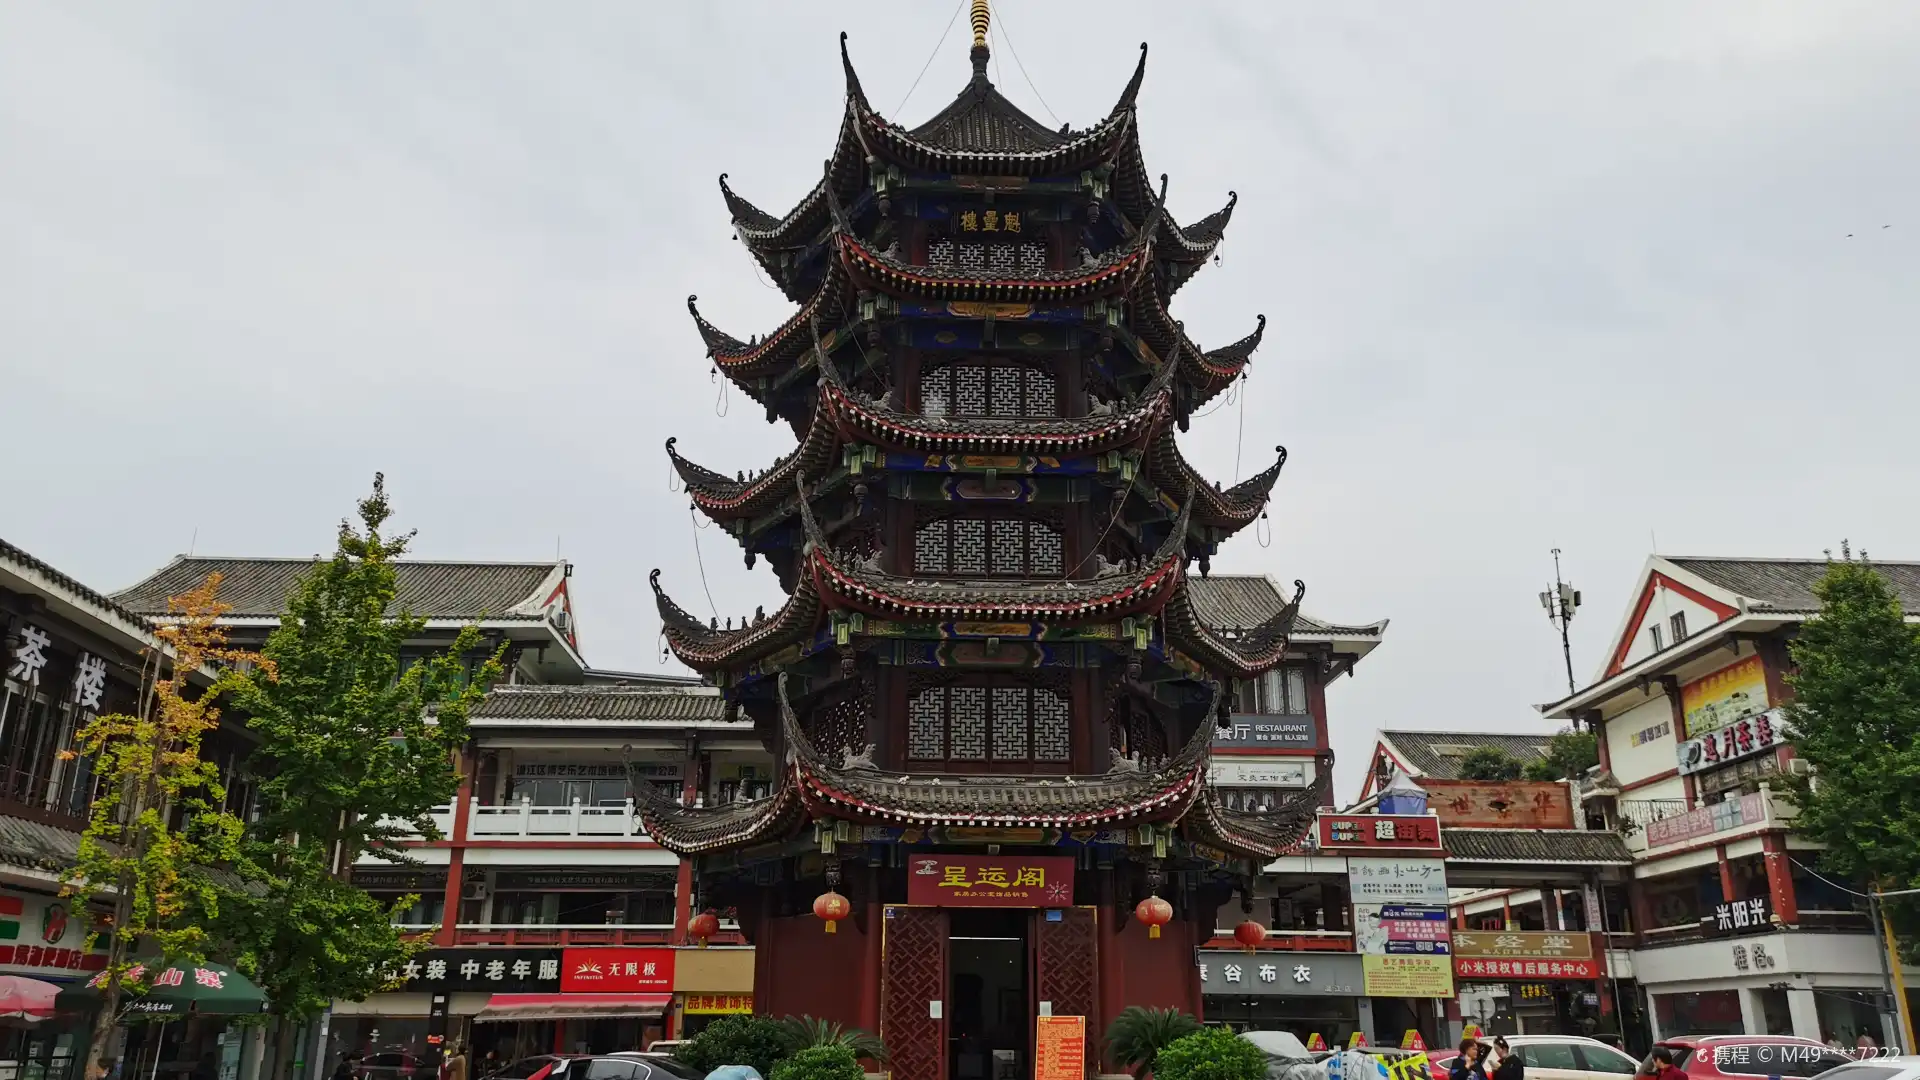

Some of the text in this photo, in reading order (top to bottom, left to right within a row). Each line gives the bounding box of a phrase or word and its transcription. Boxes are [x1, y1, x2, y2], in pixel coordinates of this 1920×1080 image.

[10, 625, 107, 711] 茶楼
[1255, 724, 1307, 732] RESTAURANT
[938, 866, 1045, 888] 呈运阁
[1701, 898, 1767, 930] 一米阳光
[460, 959, 559, 980] 中老年服
[608, 962, 656, 976] 无限极
[1460, 962, 1589, 976] 小米授权售后服务中心
